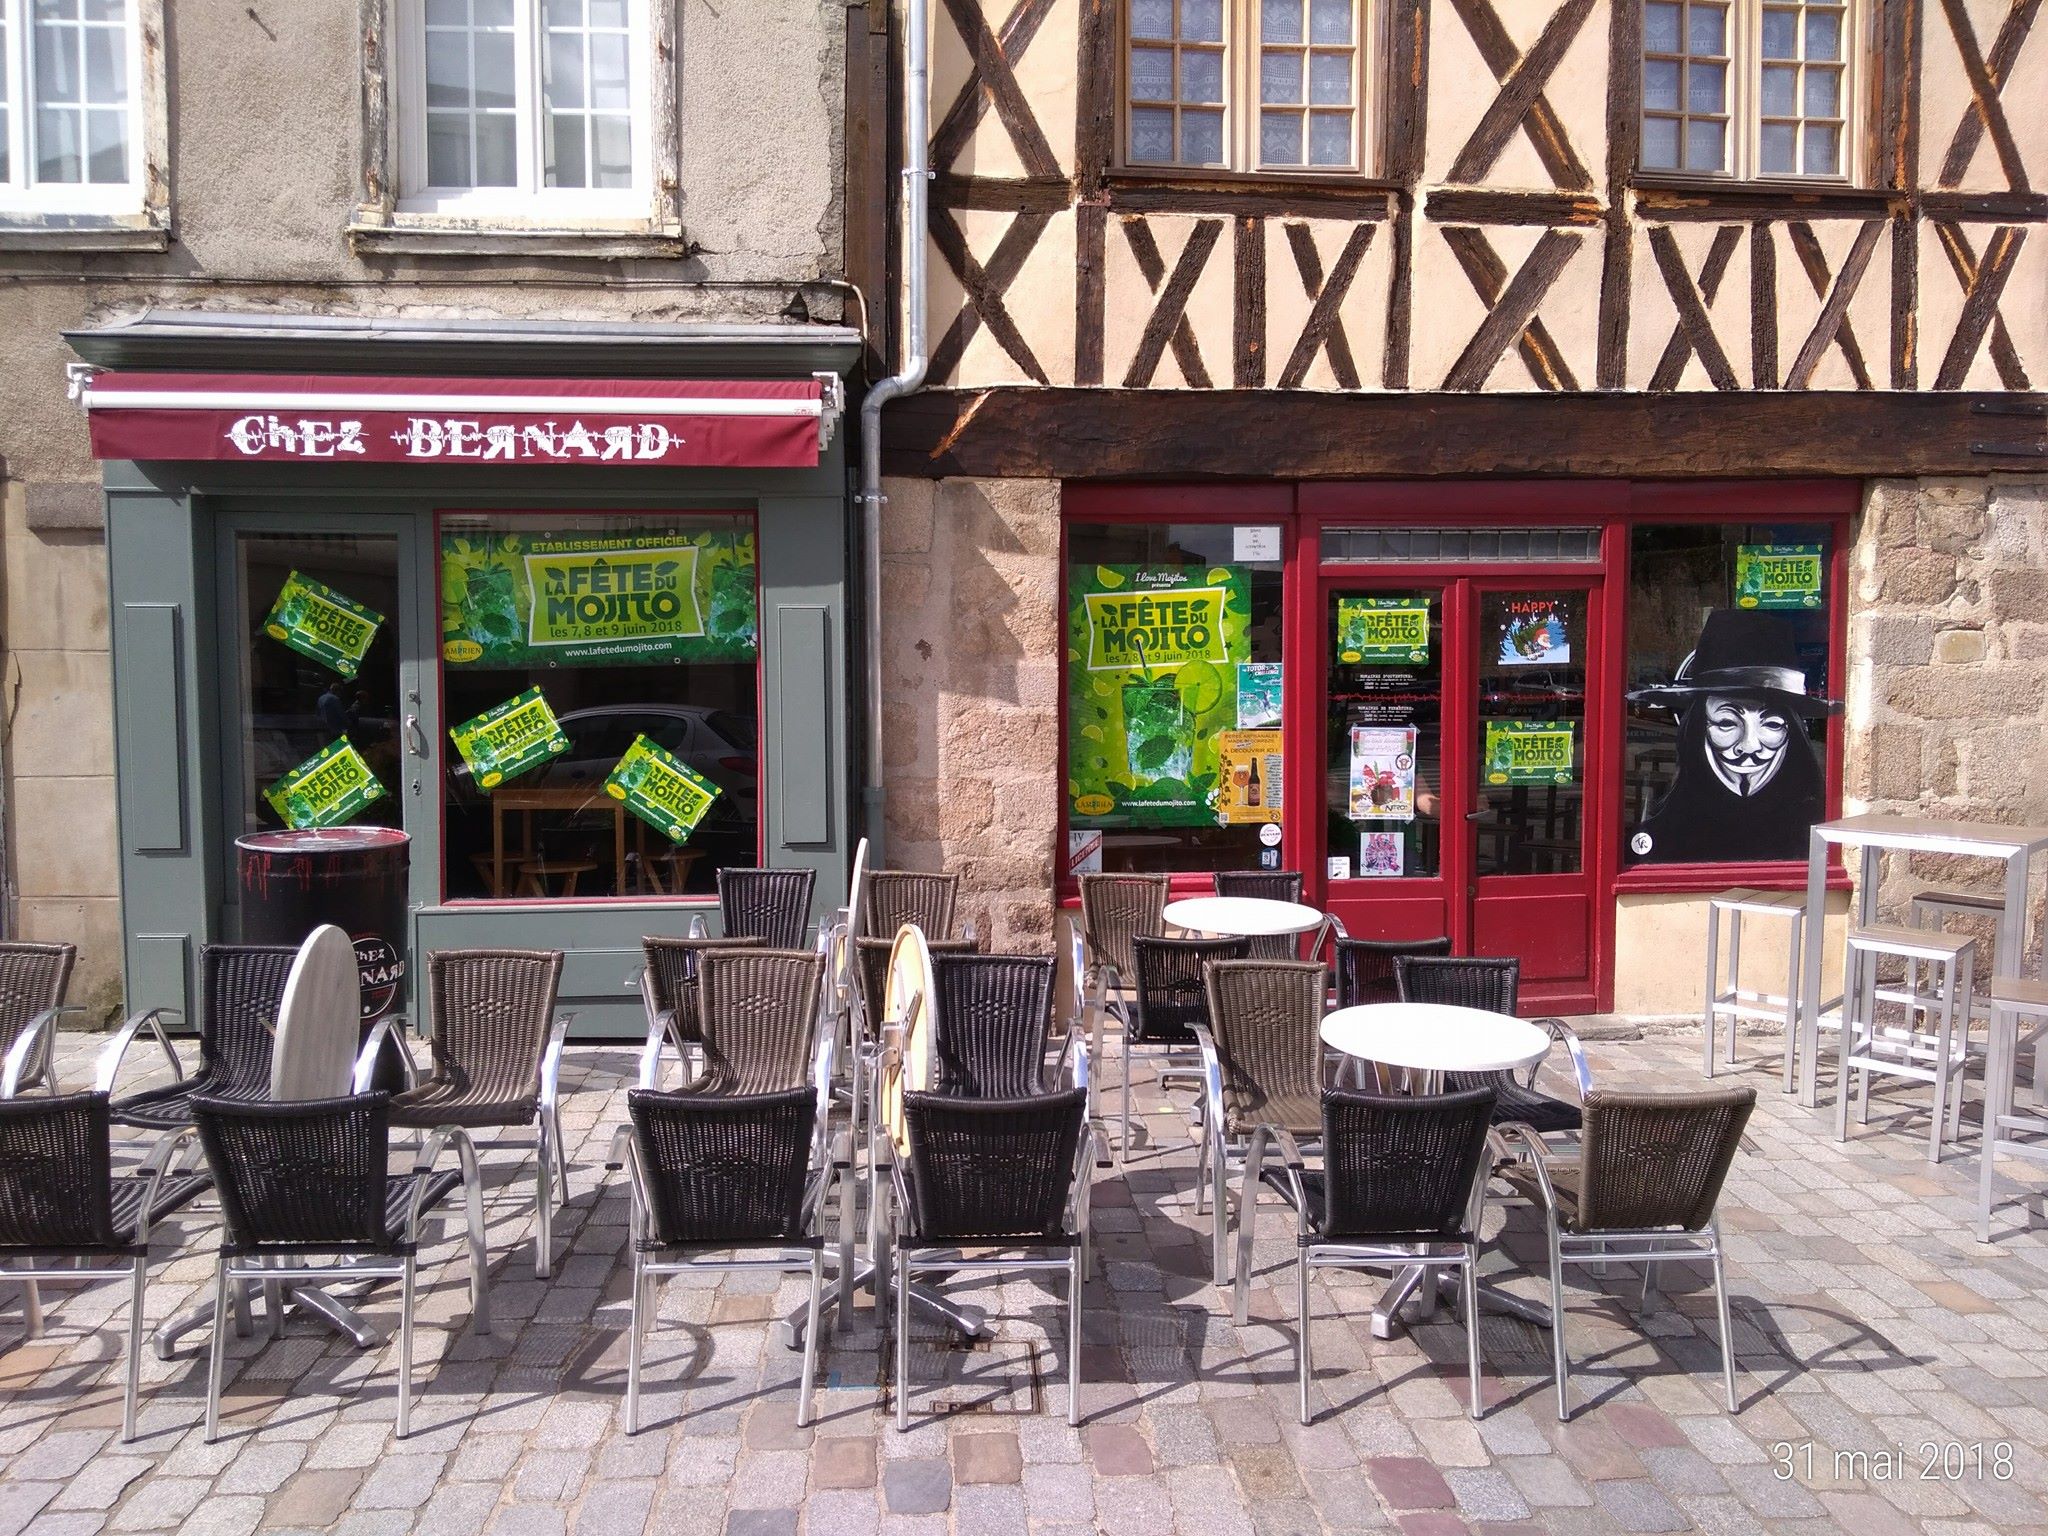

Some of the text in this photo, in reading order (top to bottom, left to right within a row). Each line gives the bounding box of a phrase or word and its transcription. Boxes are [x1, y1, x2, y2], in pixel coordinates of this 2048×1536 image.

[400, 418, 674, 460] BERNARD
[531, 536, 690, 553] ETABLISSEMENT OFFICIEL
[545, 558, 677, 596] LA FÊTE DU
[1773, 558, 1803, 572] FÊTE
[1157, 572, 1188, 585] Mojitos
[1765, 573, 1812, 584] MOJITO
[318, 606, 356, 632] FÊTE
[548, 591, 681, 625] MOJITO
[1101, 596, 1208, 628] LA FÊTE DU
[1376, 612, 1409, 626] FÊTE
[1511, 602, 1553, 613] HAPPY
[304, 613, 359, 648] MOJITO
[551, 621, 682, 638] les 7, 8 et 9 juin 2018
[1104, 625, 1210, 653] MOJITO
[1368, 627, 1419, 639] MOJITO
[565, 642, 672, 657] www.lafetedumojito.com
[1106, 653, 1120, 663] les
[1132, 652, 1139, 661] 8
[1154, 652, 1161, 661] 9
[1163, 651, 1182, 663] juin
[1185, 650, 1211, 660] 2018
[493, 719, 546, 750] MOJITO
[495, 711, 533, 738] FÊTE
[1523, 734, 1554, 748] FÊTE
[1514, 749, 1564, 761] MOJITO
[308, 761, 343, 793] FÊTE
[309, 767, 359, 808] MOJITO
[658, 771, 694, 800] FÊTE
[643, 777, 693, 816] MOJITO
[1122, 799, 1196, 807] www.lafetedumojito.com
[360, 960, 404, 986] NARD
